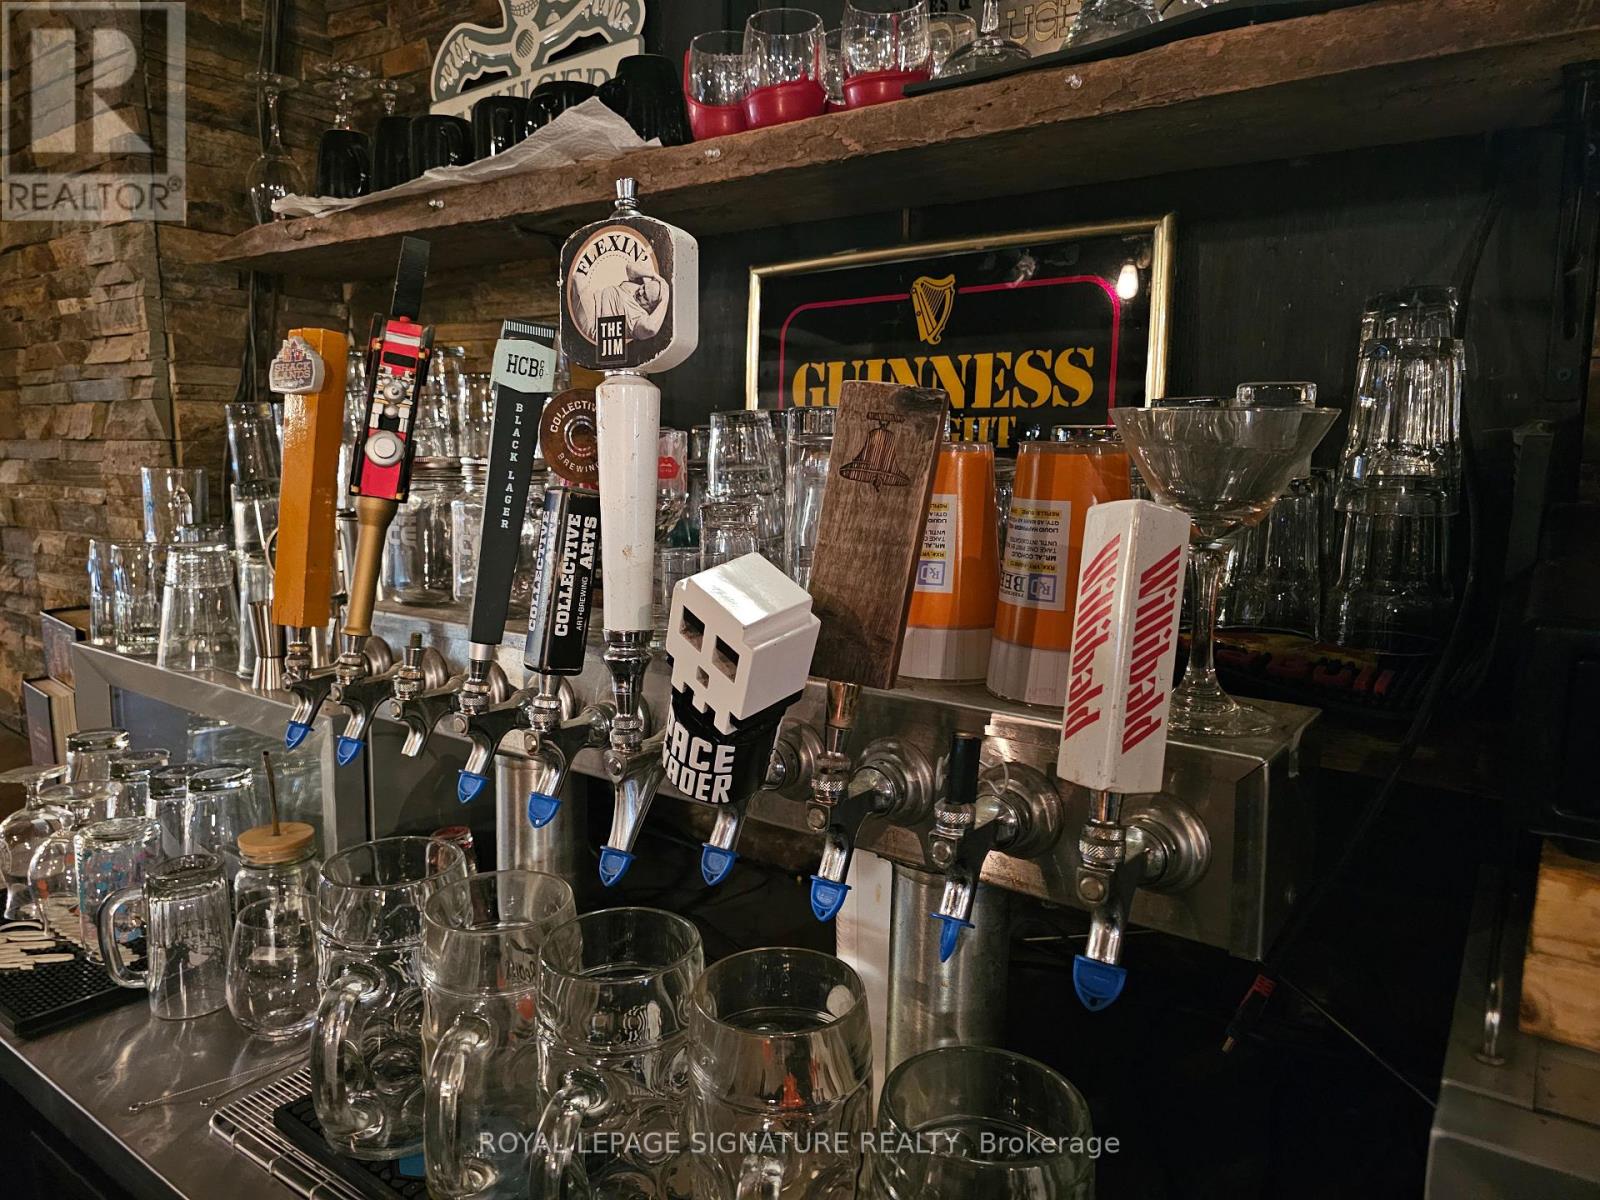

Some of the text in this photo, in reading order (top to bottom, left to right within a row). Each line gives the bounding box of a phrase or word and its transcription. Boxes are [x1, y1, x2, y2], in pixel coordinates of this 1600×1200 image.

[576, 235, 648, 276] FLEXIN'
[600, 321, 623, 338] THE
[601, 338, 623, 356] JIM
[550, 400, 597, 433] COLLECTIV
[500, 403, 524, 529] BLACK LAGER
[557, 452, 599, 473] BREWIN
[579, 516, 598, 570] ARTS
[528, 511, 550, 632] COLLECTIVE
[554, 513, 582, 637] COLLECTIVE
[1064, 534, 1121, 741] Willibald
[1121, 544, 1182, 755] Willibald
